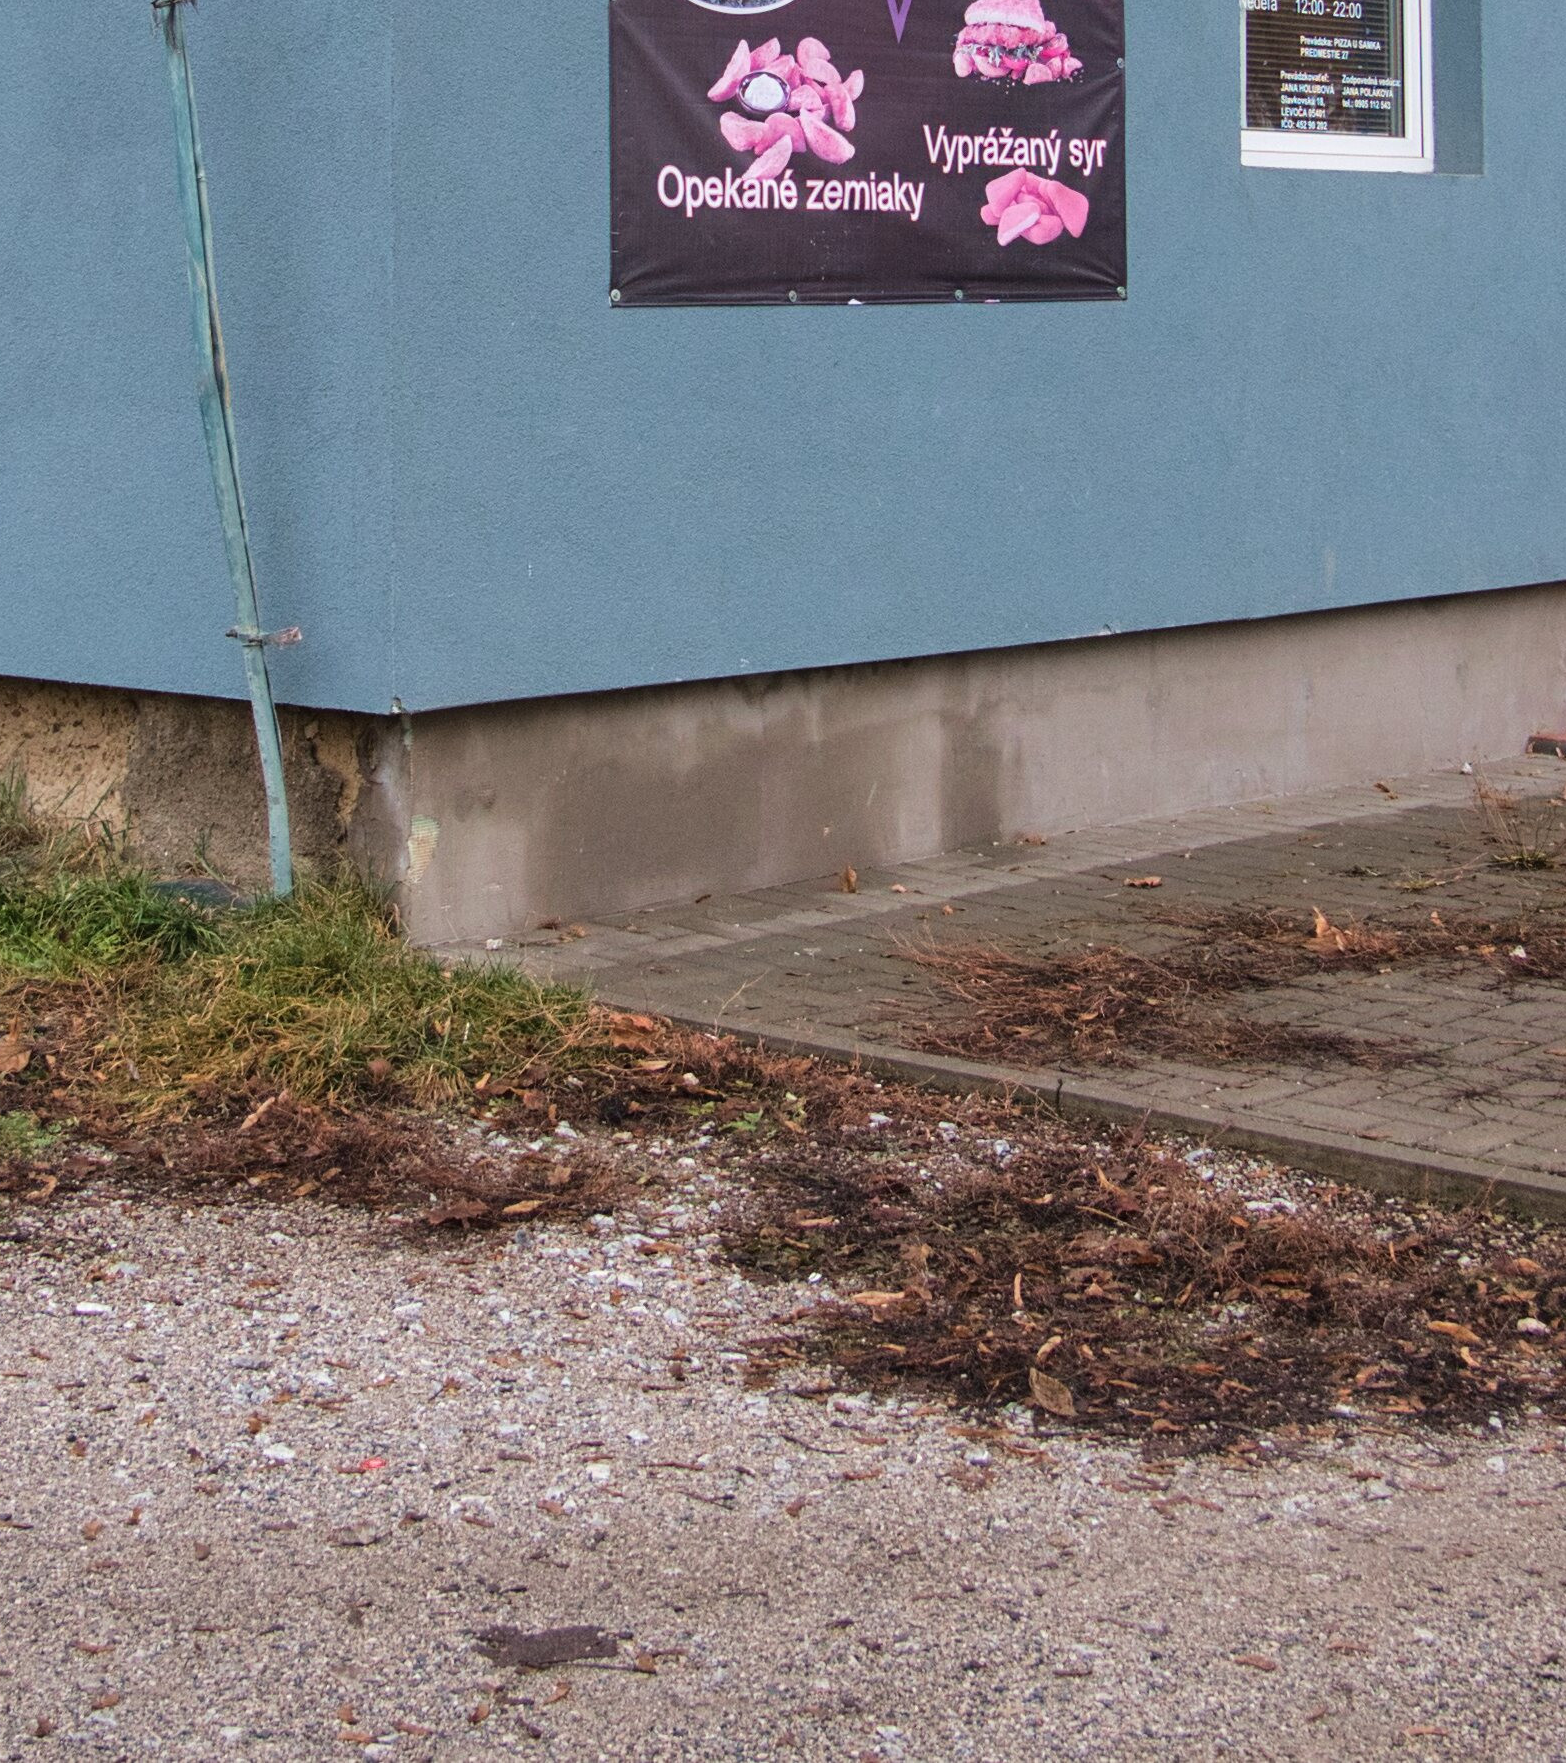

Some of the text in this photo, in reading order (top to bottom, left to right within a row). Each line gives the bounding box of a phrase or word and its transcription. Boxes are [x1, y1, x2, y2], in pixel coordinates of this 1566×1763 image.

[1333, 1, 1362, 19] 22:00
[1334, 38, 1352, 48] PIZZA
[1359, 39, 1381, 50] SAMKA
[1280, 83, 1298, 92] JANA
[1342, 86, 1359, 96] JANA
[922, 124, 1108, 177] Vyprážaný syr
[657, 164, 925, 221] Opekané zemiaky
